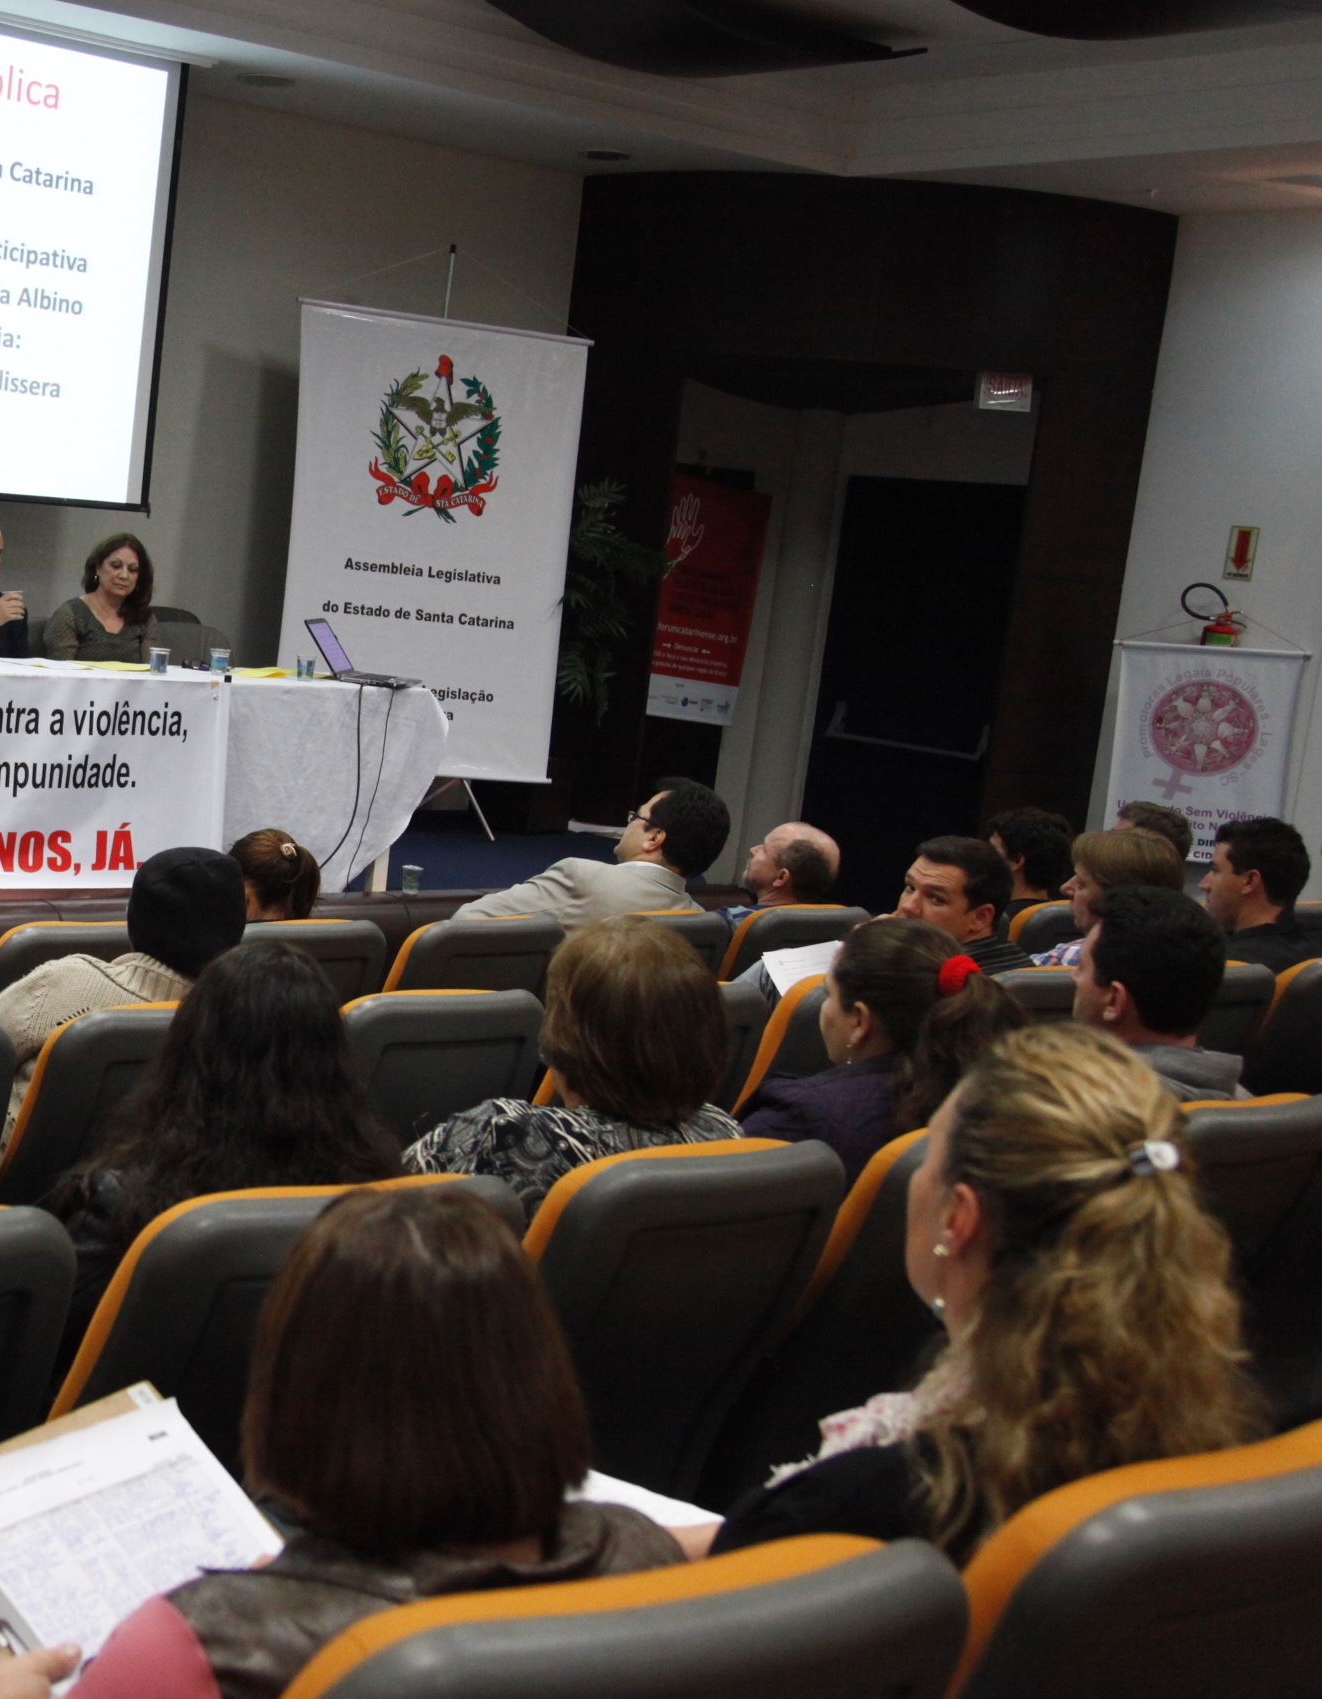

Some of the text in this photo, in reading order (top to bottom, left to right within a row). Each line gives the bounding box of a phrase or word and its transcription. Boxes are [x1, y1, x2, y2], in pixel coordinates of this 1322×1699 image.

[10, 161, 94, 195] Catarina
[17, 287, 83, 315] Albino
[379, 485, 484, 508] ESTADO DE STA CATARINA
[344, 557, 501, 585] Assembleia Legislativa
[322, 600, 514, 630] do Estado de Santa Catarina
[422, 684, 494, 704] egislação
[49, 706, 64, 735] a
[73, 700, 188, 743] violência,
[1140, 684, 1166, 759] Promotoras
[1166, 669, 1211, 686] Legais
[1217, 668, 1269, 721] Populares
[1185, 806, 1213, 817] Sem
